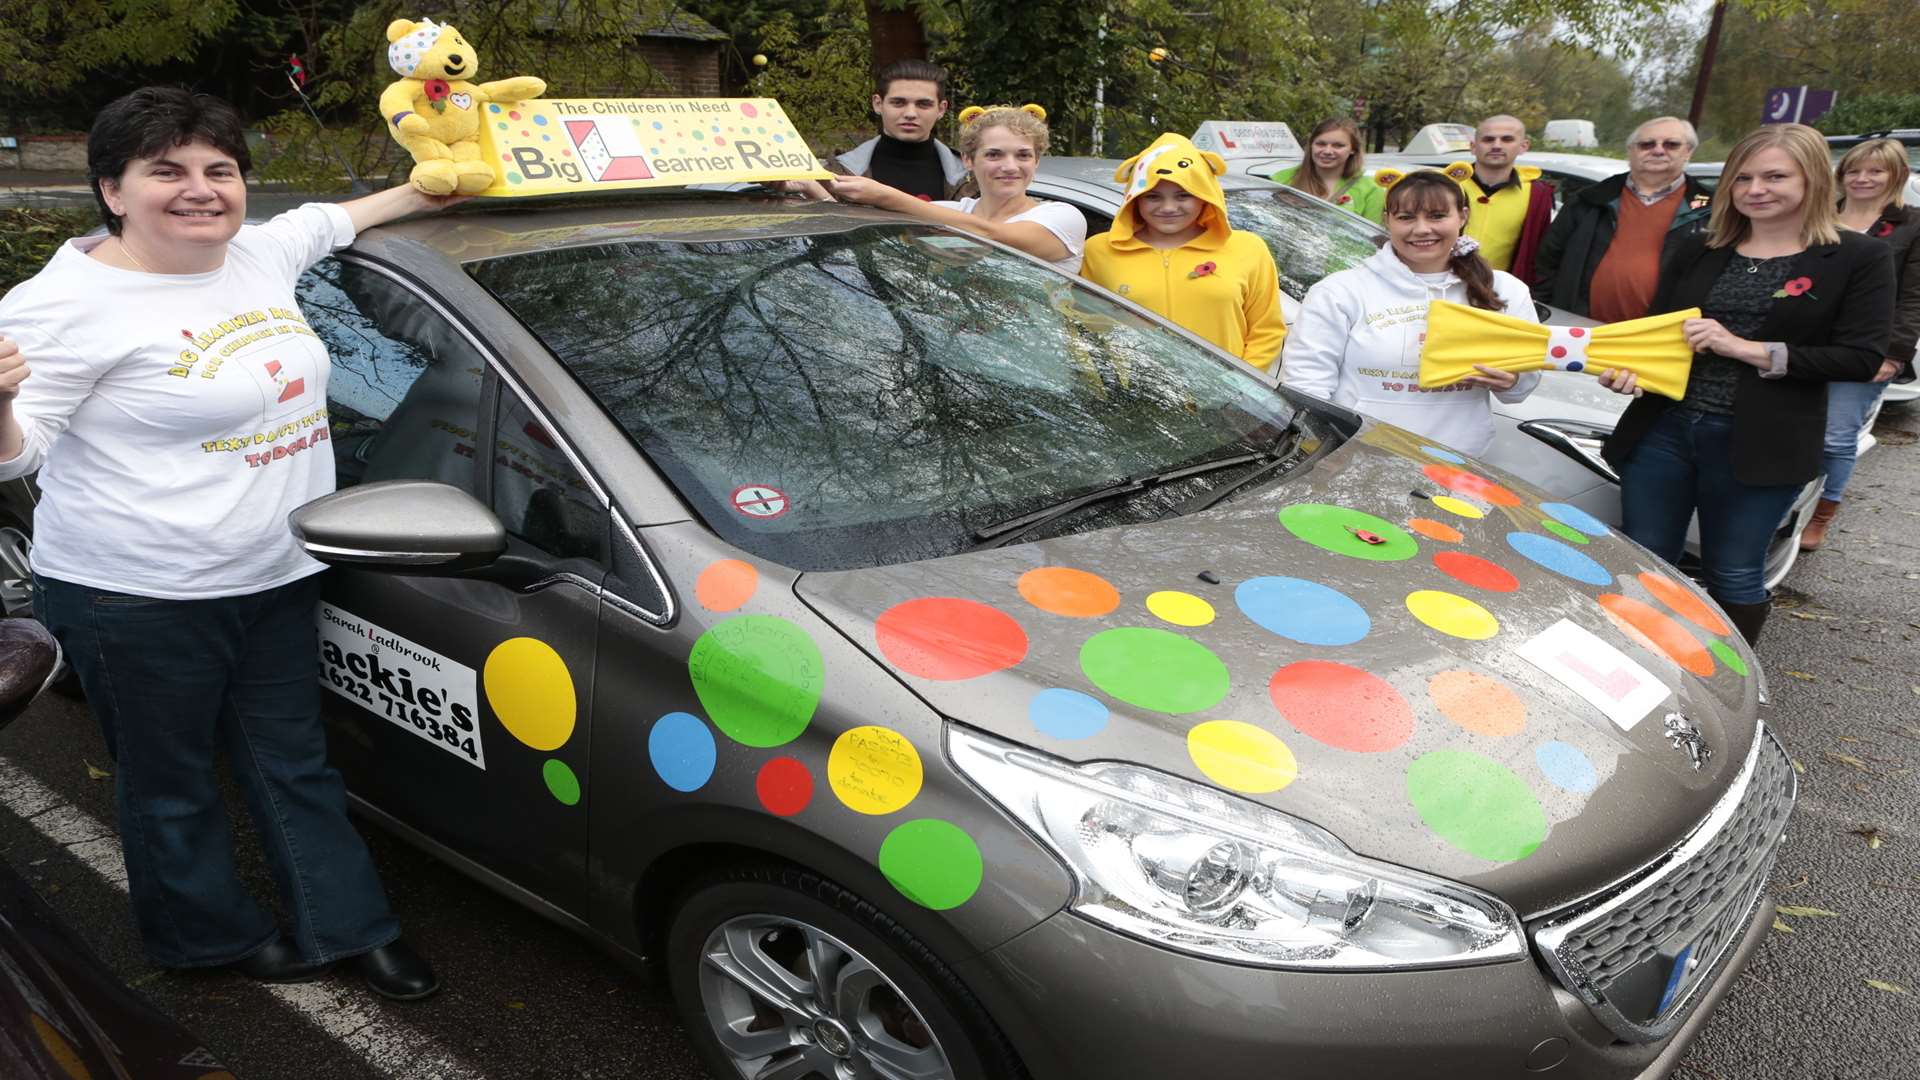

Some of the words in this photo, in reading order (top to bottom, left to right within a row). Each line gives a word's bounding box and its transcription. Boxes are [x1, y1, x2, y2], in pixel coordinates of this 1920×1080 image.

[552, 102, 588, 115] The
[592, 102, 664, 115] Children
[670, 101, 685, 113] in
[688, 101, 731, 113] Need
[511, 146, 583, 183] Big
[734, 140, 814, 172] Relay
[168, 350, 199, 379] BIG
[192, 311, 268, 351] LEARNER
[202, 437, 251, 453] TEXT
[245, 451, 272, 468] TO
[323, 608, 365, 638] Sarah
[368, 628, 441, 672] Ladbrook
[321, 639, 474, 733] ackie's
[378, 691, 478, 761] 716384
